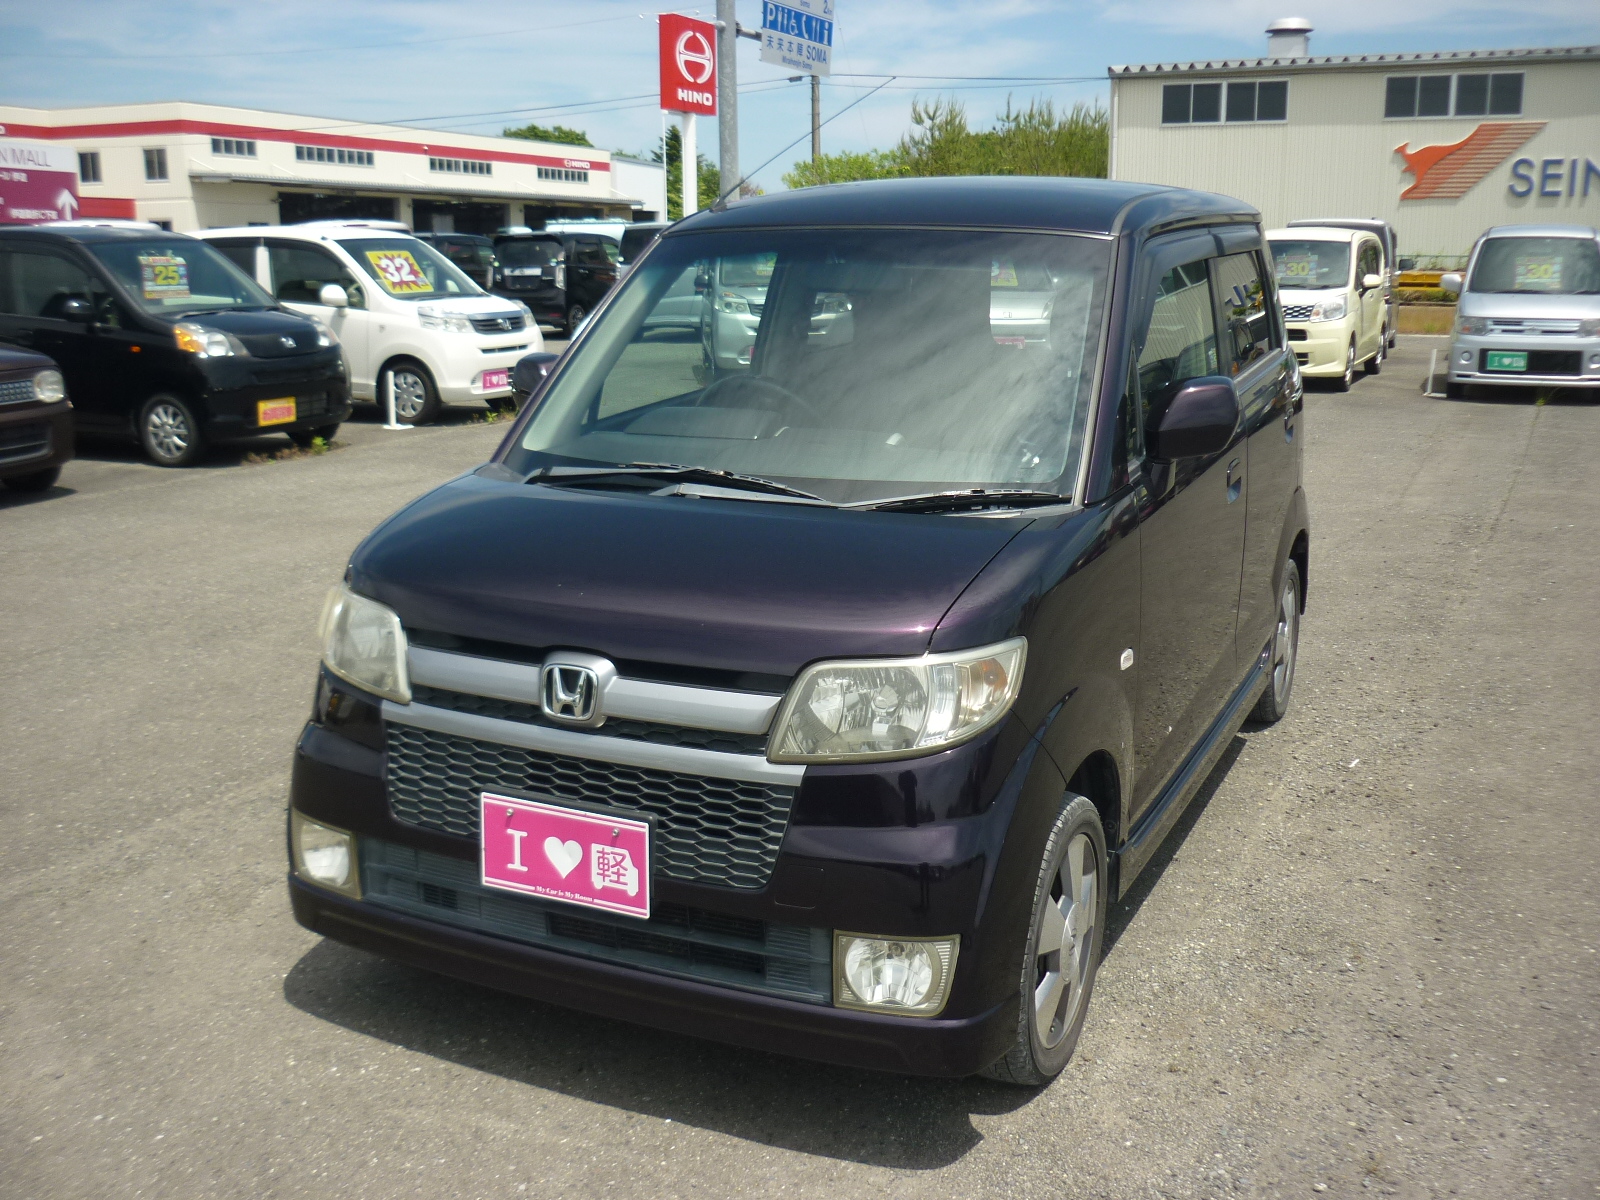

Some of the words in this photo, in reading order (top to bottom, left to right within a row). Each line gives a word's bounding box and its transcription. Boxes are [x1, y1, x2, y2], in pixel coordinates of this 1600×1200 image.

[806, 45, 828, 65] SOMA
[677, 88, 713, 106] HINO
[10, 147, 52, 167] MALL
[571, 160, 590, 169] HINO
[154, 265, 180, 286] 25
[379, 257, 417, 283] 32
[1286, 261, 1310, 276] 30
[1527, 263, 1553, 279] 30
[506, 828, 529, 872] I
[595, 846, 630, 888] 軽
